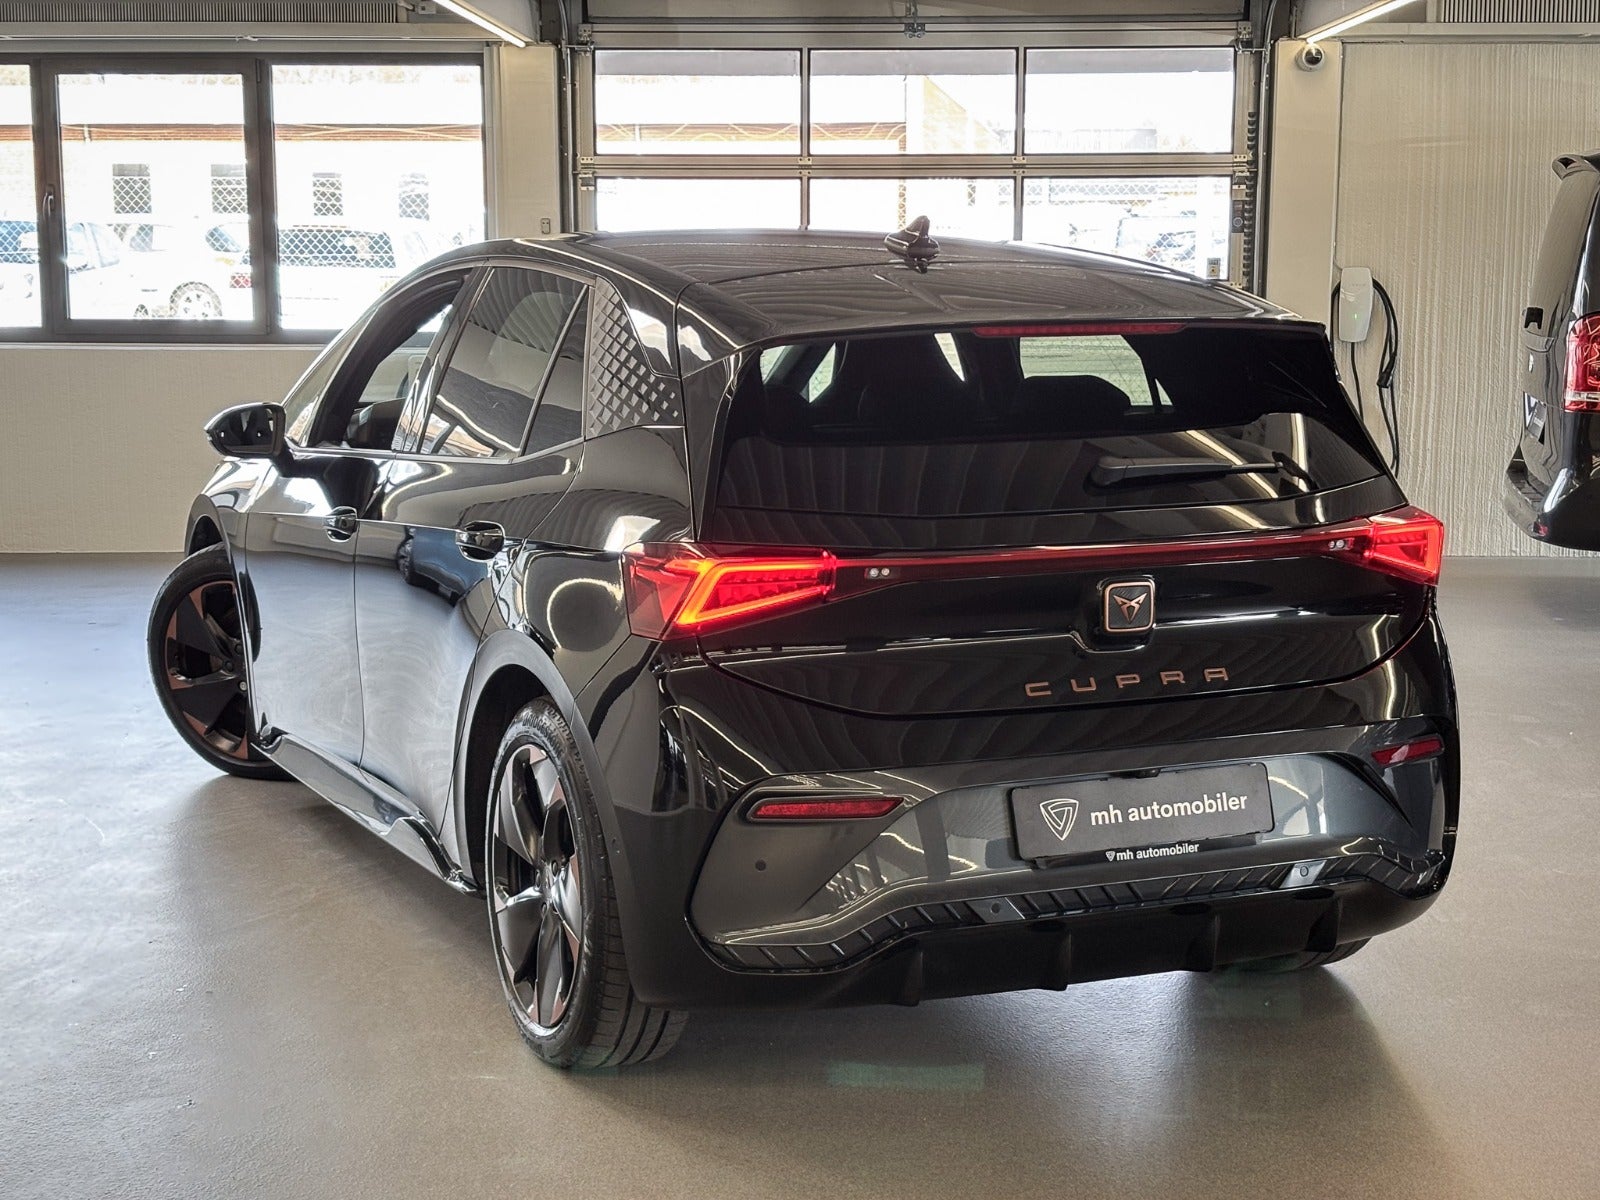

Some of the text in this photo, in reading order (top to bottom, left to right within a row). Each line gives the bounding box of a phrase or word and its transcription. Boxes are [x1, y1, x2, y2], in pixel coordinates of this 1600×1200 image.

[1024, 666, 1229, 697] CUPRA
[1090, 791, 1248, 826] mh automobiler
[1116, 843, 1200, 861] mh automobiler
